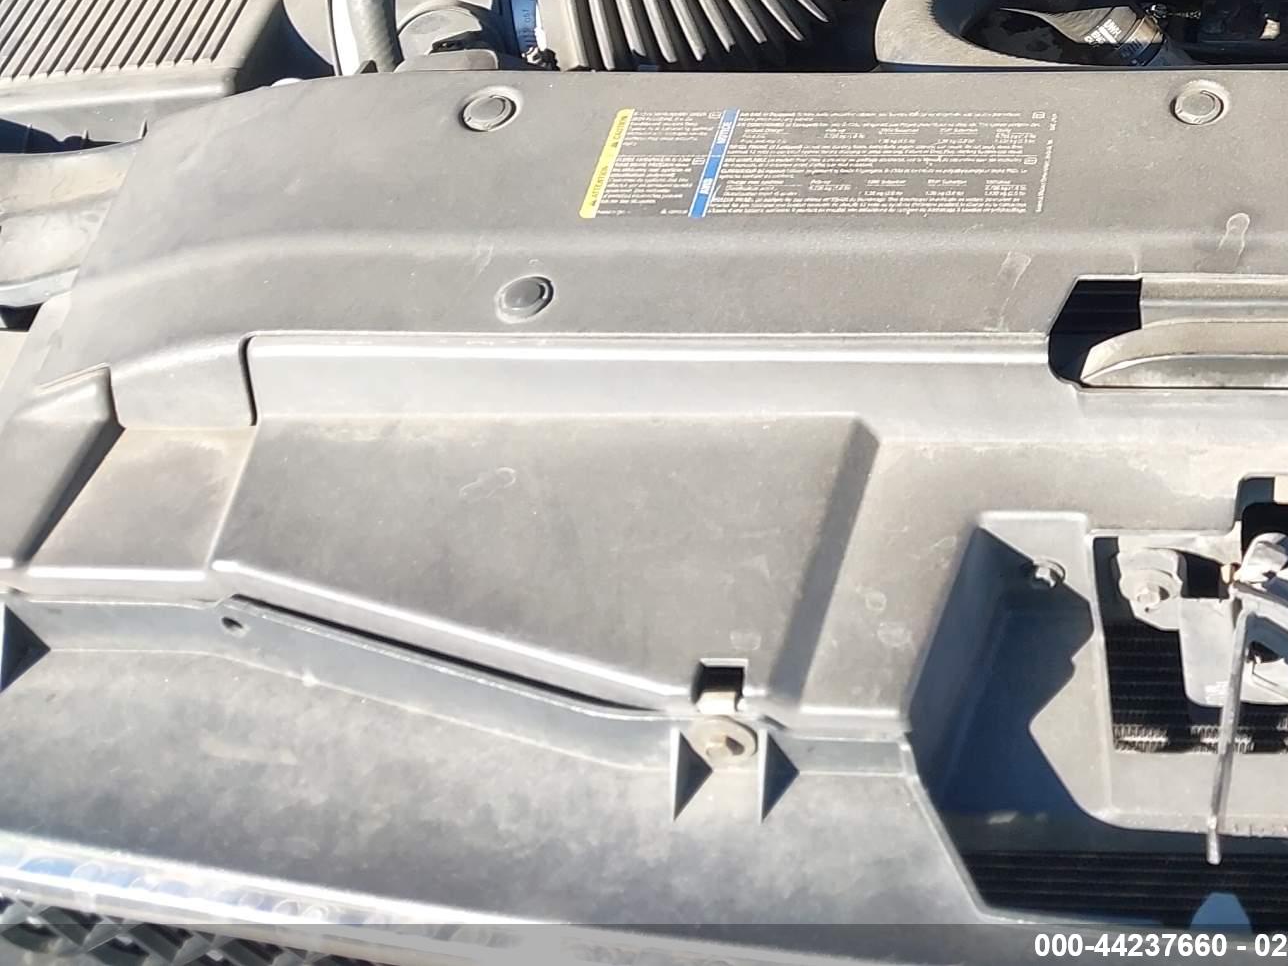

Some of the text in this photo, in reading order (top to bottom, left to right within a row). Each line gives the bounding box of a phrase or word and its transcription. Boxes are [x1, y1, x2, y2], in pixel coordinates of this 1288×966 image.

[613, 115, 628, 140] CAUTION
[716, 121, 732, 144] NOTICE
[594, 165, 609, 199] ATTENTION
